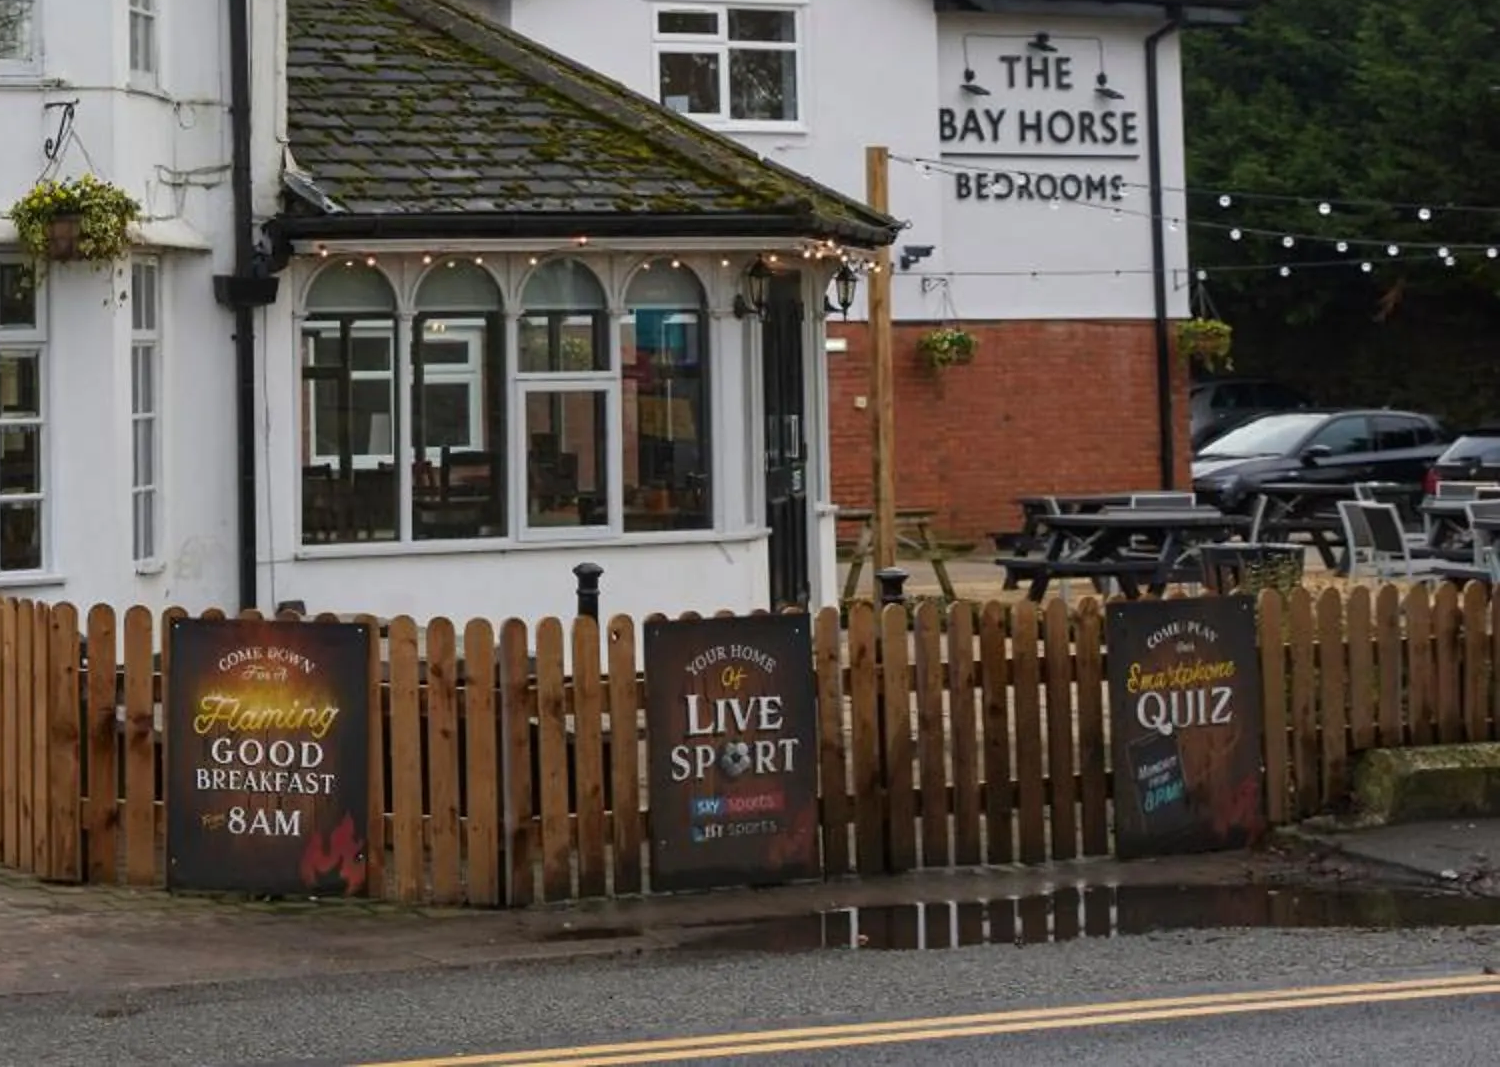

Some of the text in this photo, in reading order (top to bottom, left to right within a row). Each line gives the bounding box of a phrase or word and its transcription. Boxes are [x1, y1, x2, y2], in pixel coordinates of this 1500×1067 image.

[999, 55, 1074, 90] THE
[939, 108, 1138, 145] BAY HORSE
[219, 646, 315, 674] COME DOWN
[685, 644, 778, 677] YOUR HOME
[193, 696, 340, 738] Flaming
[685, 694, 785, 736] LIVE
[1137, 686, 1234, 736] QUIZ
[211, 738, 324, 769] GOOD
[196, 768, 335, 794] BREAKFAST
[228, 805, 302, 837] 8AM
